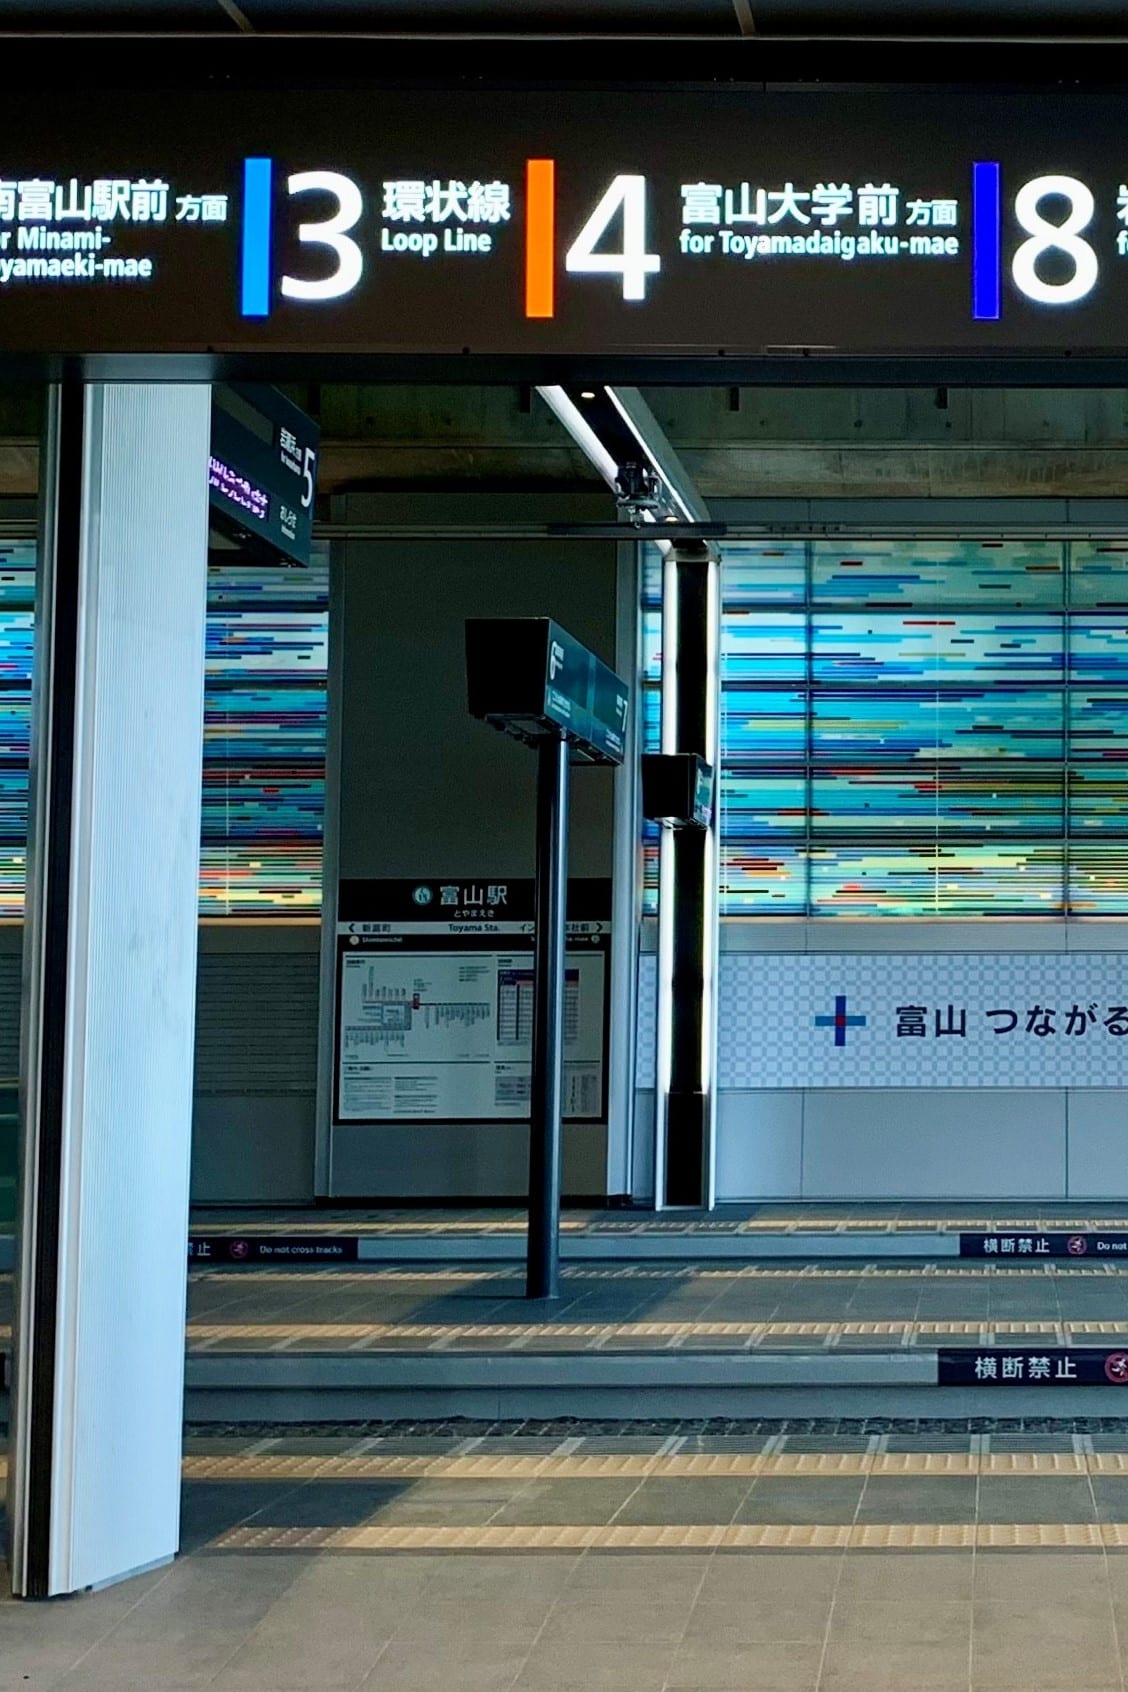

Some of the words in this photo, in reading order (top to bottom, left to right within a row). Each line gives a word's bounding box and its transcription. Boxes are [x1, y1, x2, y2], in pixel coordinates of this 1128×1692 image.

[175, 194, 229, 221] 方面
[382, 180, 512, 223] 環状線
[680, 181, 900, 226] 富山大学前
[905, 199, 958, 226] 方面
[17, 225, 112, 250] Minami-
[281, 170, 364, 300] 3
[382, 228, 438, 258] Loop
[444, 228, 492, 253] Line
[565, 174, 661, 301] 4
[679, 229, 715, 254] for
[718, 230, 960, 260] Toyamadaigaku-mae
[1011, 174, 1099, 303] 8
[301, 447, 316, 508] 5
[440, 884, 508, 906] 富山駅
[449, 922, 482, 935] Toyama
[453, 909, 495, 918] とやまえき
[895, 1004, 968, 1038] 富山
[983, 1238, 1050, 1254] 横断禁止
[1097, 1241, 1109, 1251] Do
[1112, 1241, 1127, 1251] not
[974, 1356, 1078, 1379] 横断禁止
